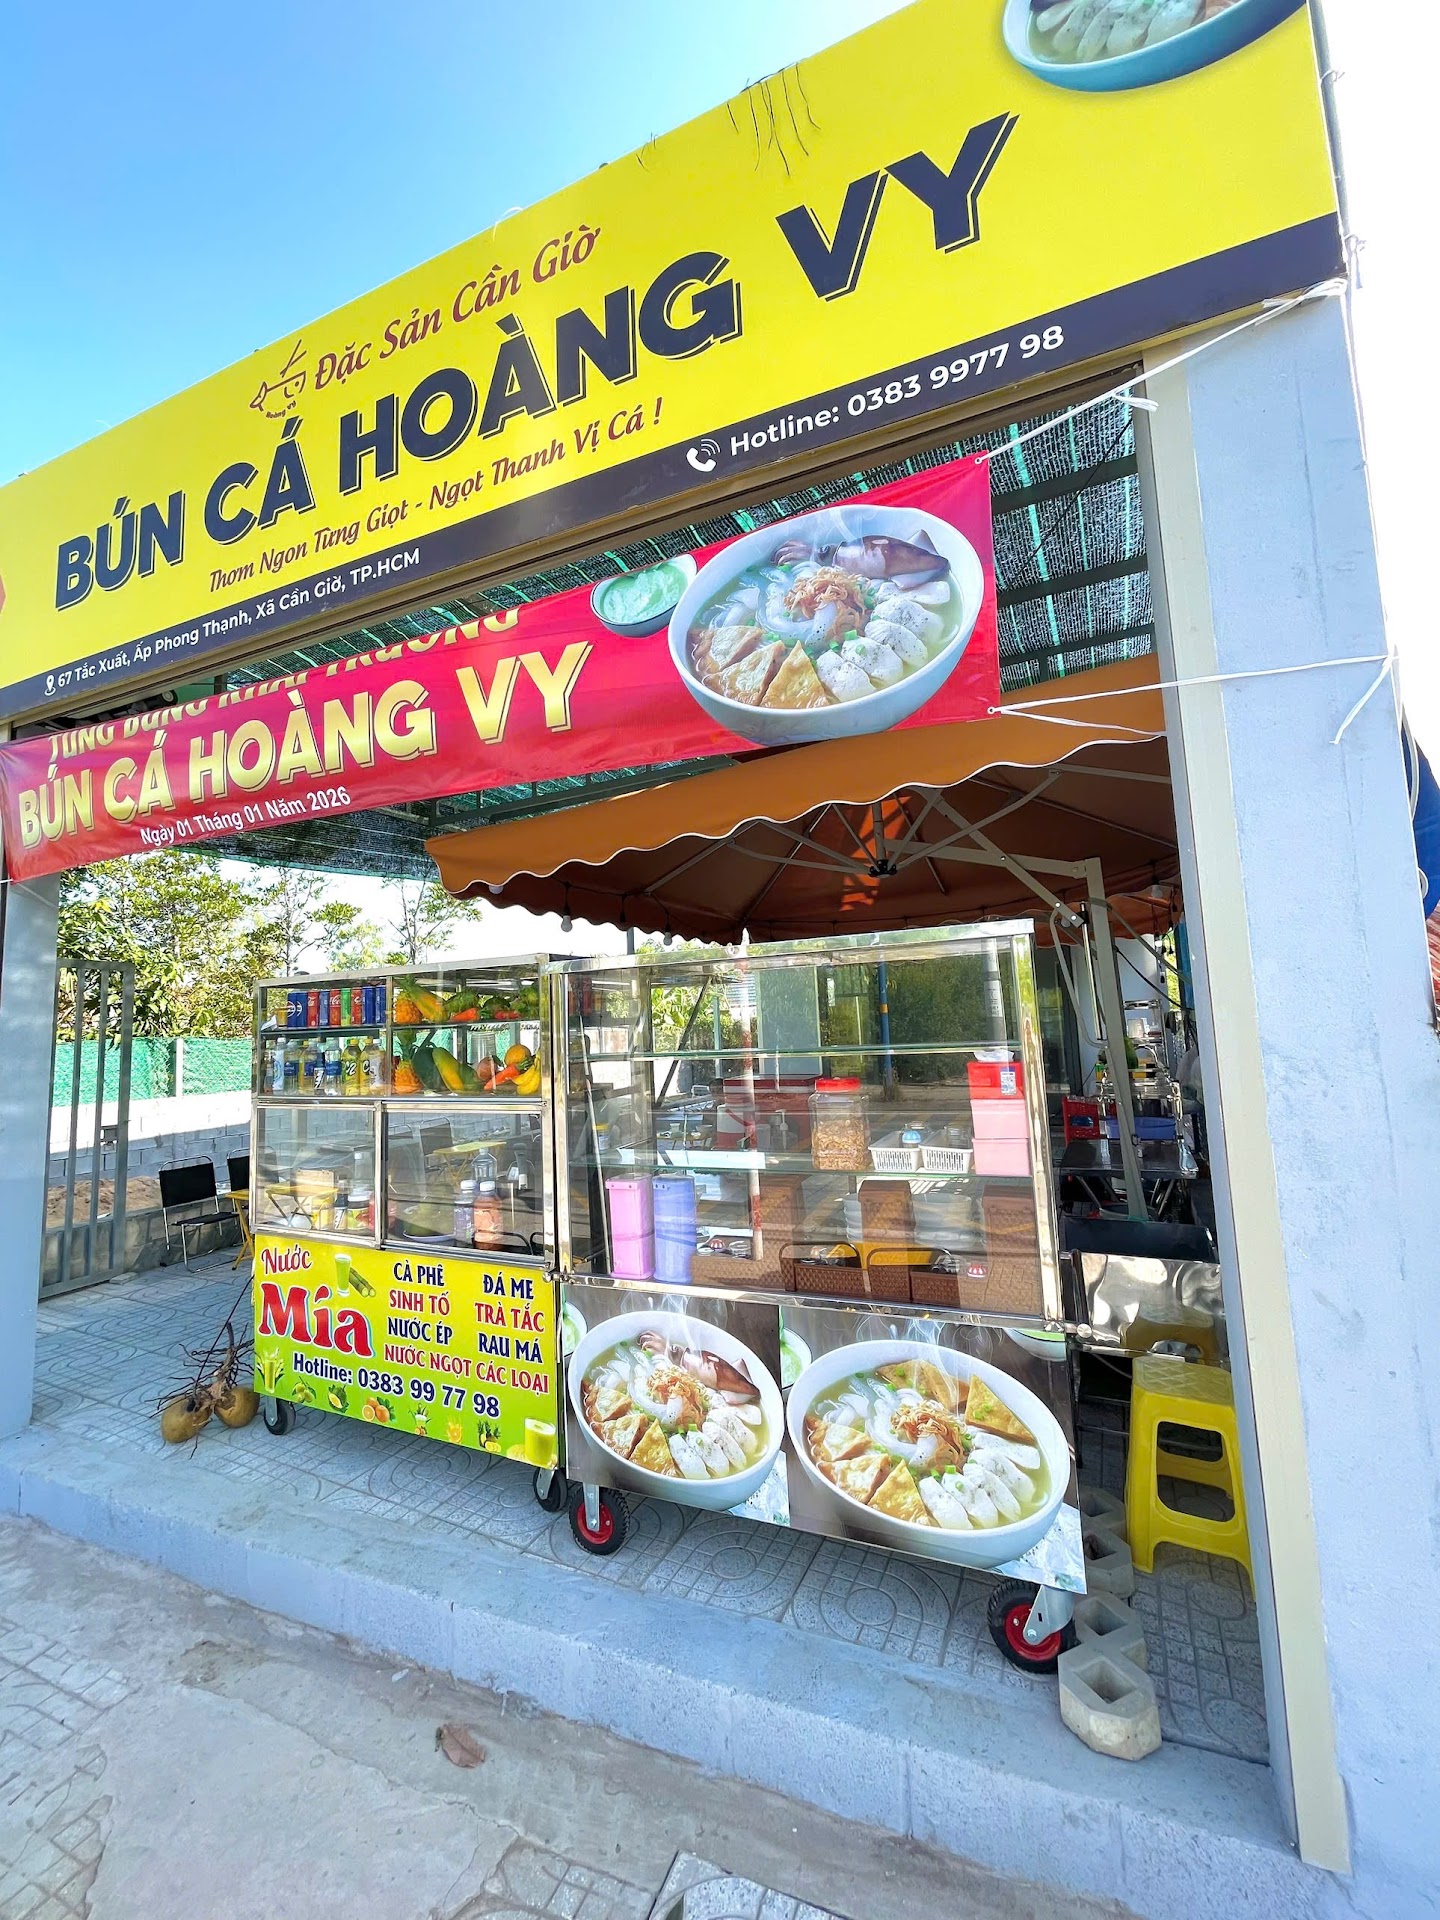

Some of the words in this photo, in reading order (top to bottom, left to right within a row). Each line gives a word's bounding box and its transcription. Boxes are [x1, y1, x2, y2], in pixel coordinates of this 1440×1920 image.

[315, 341, 373, 391] Đặc
[379, 308, 442, 358] Sản
[452, 264, 522, 322] Cần
[532, 224, 601, 283] Giờ
[55, 490, 185, 611] BÚN
[204, 415, 316, 545] CÁ
[339, 251, 741, 495] HOÀNG
[776, 111, 1019, 302] VY
[730, 401, 842, 458] Hotline:
[847, 373, 922, 418] 0383
[929, 345, 1009, 391] 9977
[1020, 325, 1065, 359] 98
[210, 561, 255, 593] Thơm
[260, 545, 308, 574] Ngon
[314, 518, 360, 550] Từng
[367, 501, 409, 536] Giọt
[429, 471, 484, 511] Ngọt
[492, 439, 566, 485] Thanh
[573, 420, 600, 454] Vị
[607, 405, 644, 441] Cá
[652, 396, 664, 428] !
[57, 672, 73, 688] 67
[74, 663, 96, 683] Tắc
[98, 651, 131, 675] Xuất,
[133, 642, 151, 664] Ấp
[155, 628, 199, 655] Phong
[202, 610, 252, 635] Thạnh,
[255, 598, 275, 619] Xã
[279, 585, 309, 611] Cần
[314, 574, 346, 599] Giờ,
[350, 548, 421, 586] TP.HCM
[18, 764, 94, 849] BÚN
[103, 730, 175, 824] CÁ
[188, 680, 437, 803] HOÀNG
[454, 641, 593, 745] VY
[140, 825, 175, 846] Ngày
[176, 821, 194, 837] 01
[194, 810, 243, 831] Tháng
[244, 803, 264, 824] 01
[265, 798, 306, 819] Năm
[306, 785, 351, 812] 2026
[261, 1244, 312, 1277] Nước
[393, 1259, 414, 1282] CÀ
[417, 1262, 445, 1287] PHÊ
[483, 1272, 506, 1297] ĐÁ
[511, 1278, 534, 1300] ME
[258, 1282, 376, 1358] Mía
[388, 1316, 431, 1341] NƯỚC
[435, 1319, 453, 1346] ÉP
[389, 1290, 424, 1312] SINH
[428, 1291, 450, 1316] TỐ
[475, 1301, 506, 1328] TRÀ
[510, 1305, 545, 1333] TẮC
[384, 1344, 425, 1368] NƯỚC
[429, 1356, 471, 1384] NGỌT
[476, 1362, 507, 1385] CÁC
[511, 1369, 549, 1396] LOẠI
[478, 1333, 510, 1359] RAU
[515, 1338, 543, 1364] MÁ
[293, 1353, 352, 1385] Hotline:
[358, 1368, 403, 1396] 0383
[410, 1380, 435, 1402] 99
[442, 1388, 466, 1410] 77
[474, 1393, 500, 1418] 98
